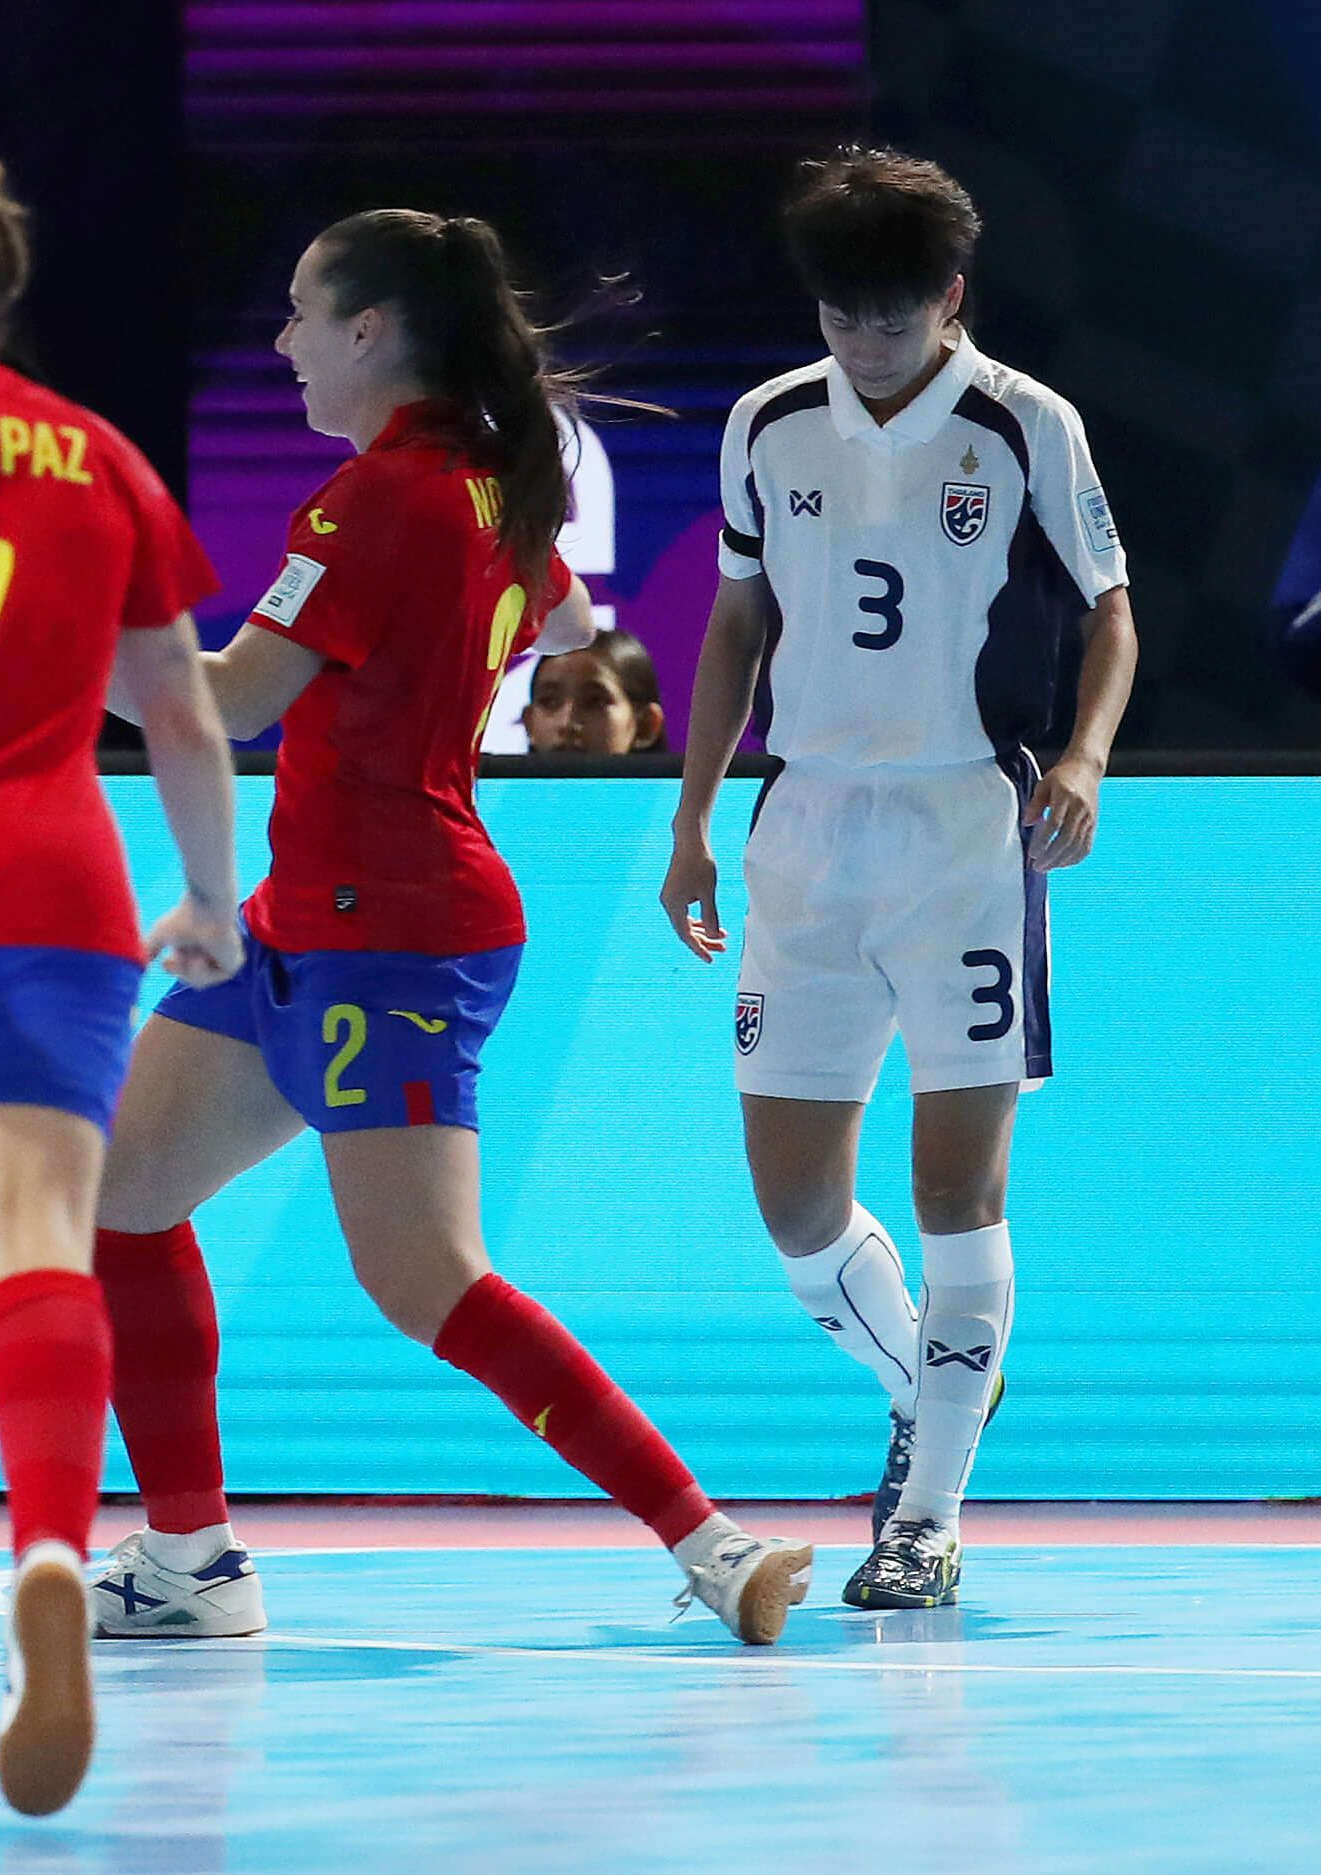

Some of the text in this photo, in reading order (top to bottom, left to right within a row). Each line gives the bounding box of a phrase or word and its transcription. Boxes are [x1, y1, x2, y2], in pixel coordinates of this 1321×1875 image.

[465, 477, 503, 529] NO
[852, 558, 905, 651] 3
[961, 948, 1014, 1042] 3
[322, 1003, 367, 1108] 2
